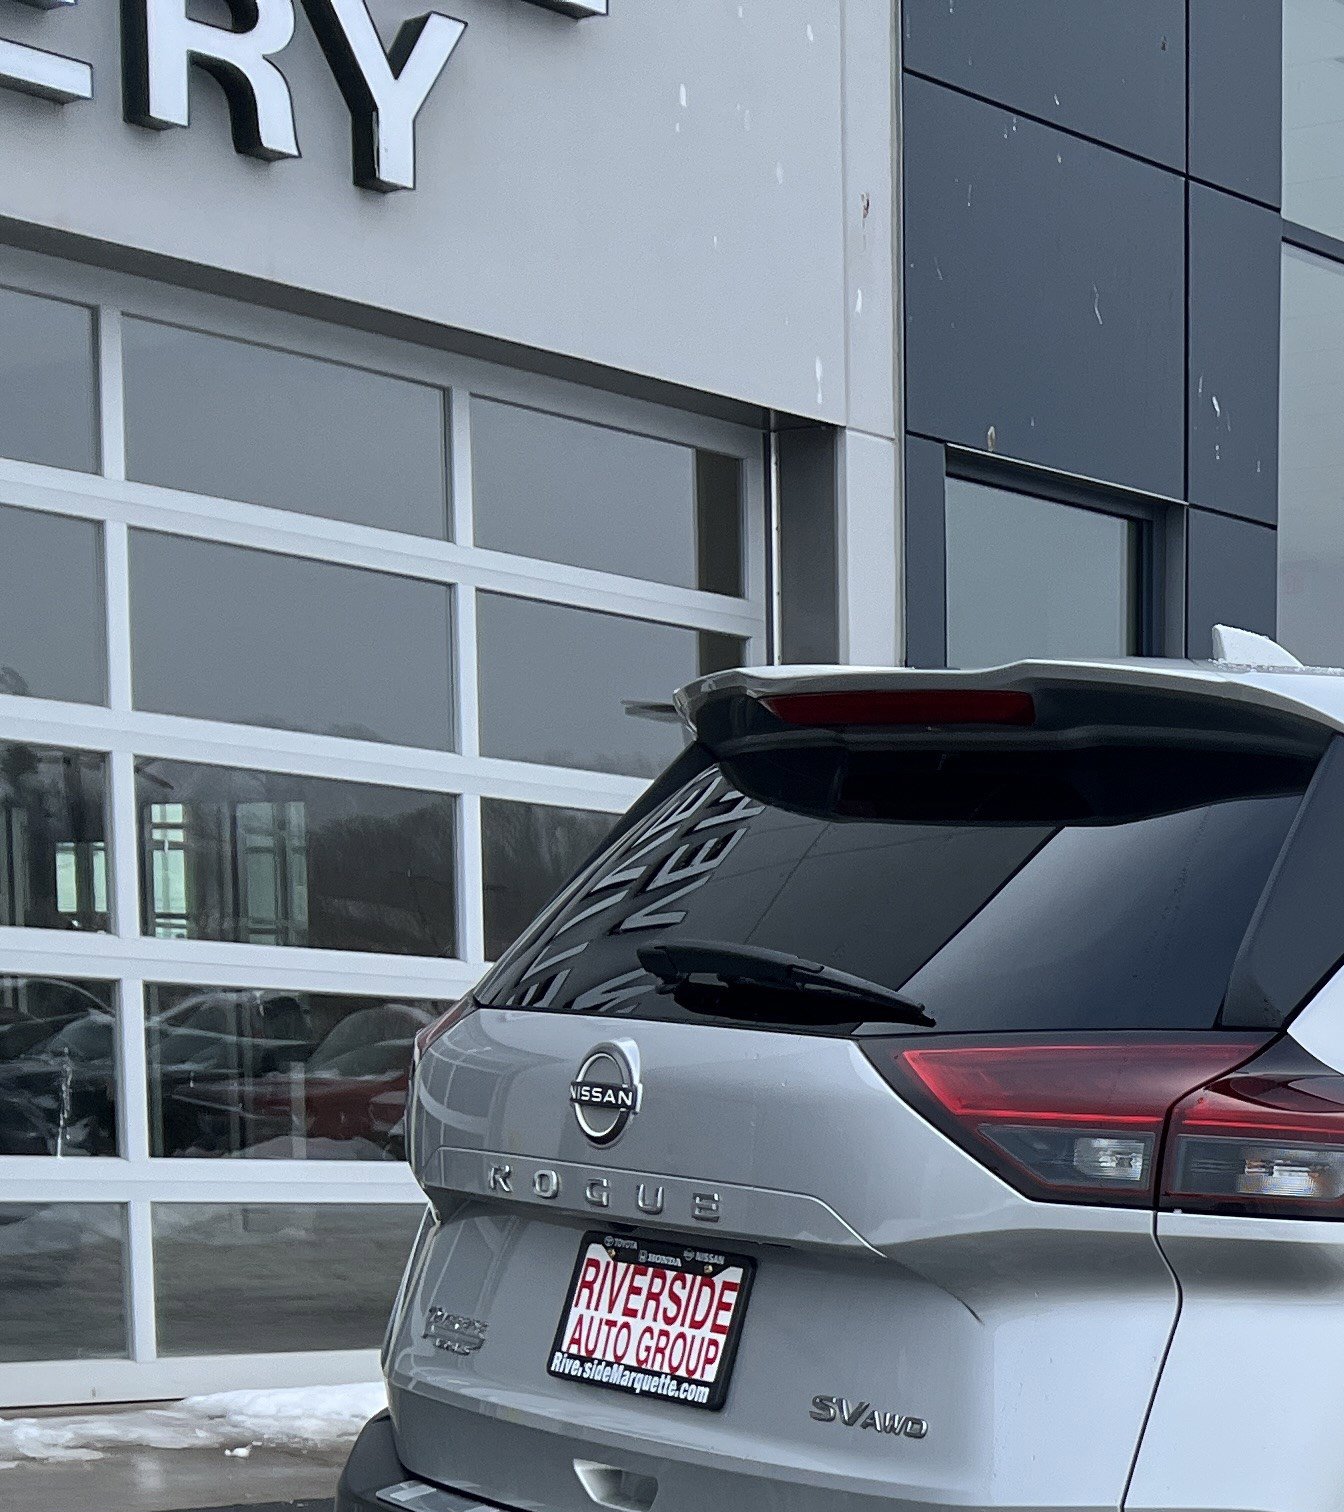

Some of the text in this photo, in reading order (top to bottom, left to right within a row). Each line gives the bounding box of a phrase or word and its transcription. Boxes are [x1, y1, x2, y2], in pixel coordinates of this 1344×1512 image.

[569, 1083, 633, 1107] NISSAN
[488, 1164, 721, 1222] ROGUE
[614, 1238, 638, 1250] TOYOTA
[648, 1252, 682, 1267] HONDA
[695, 1250, 726, 1265] NISSAN
[573, 1257, 741, 1336] RIVERSIDE
[566, 1313, 721, 1379] AUTO GROUP
